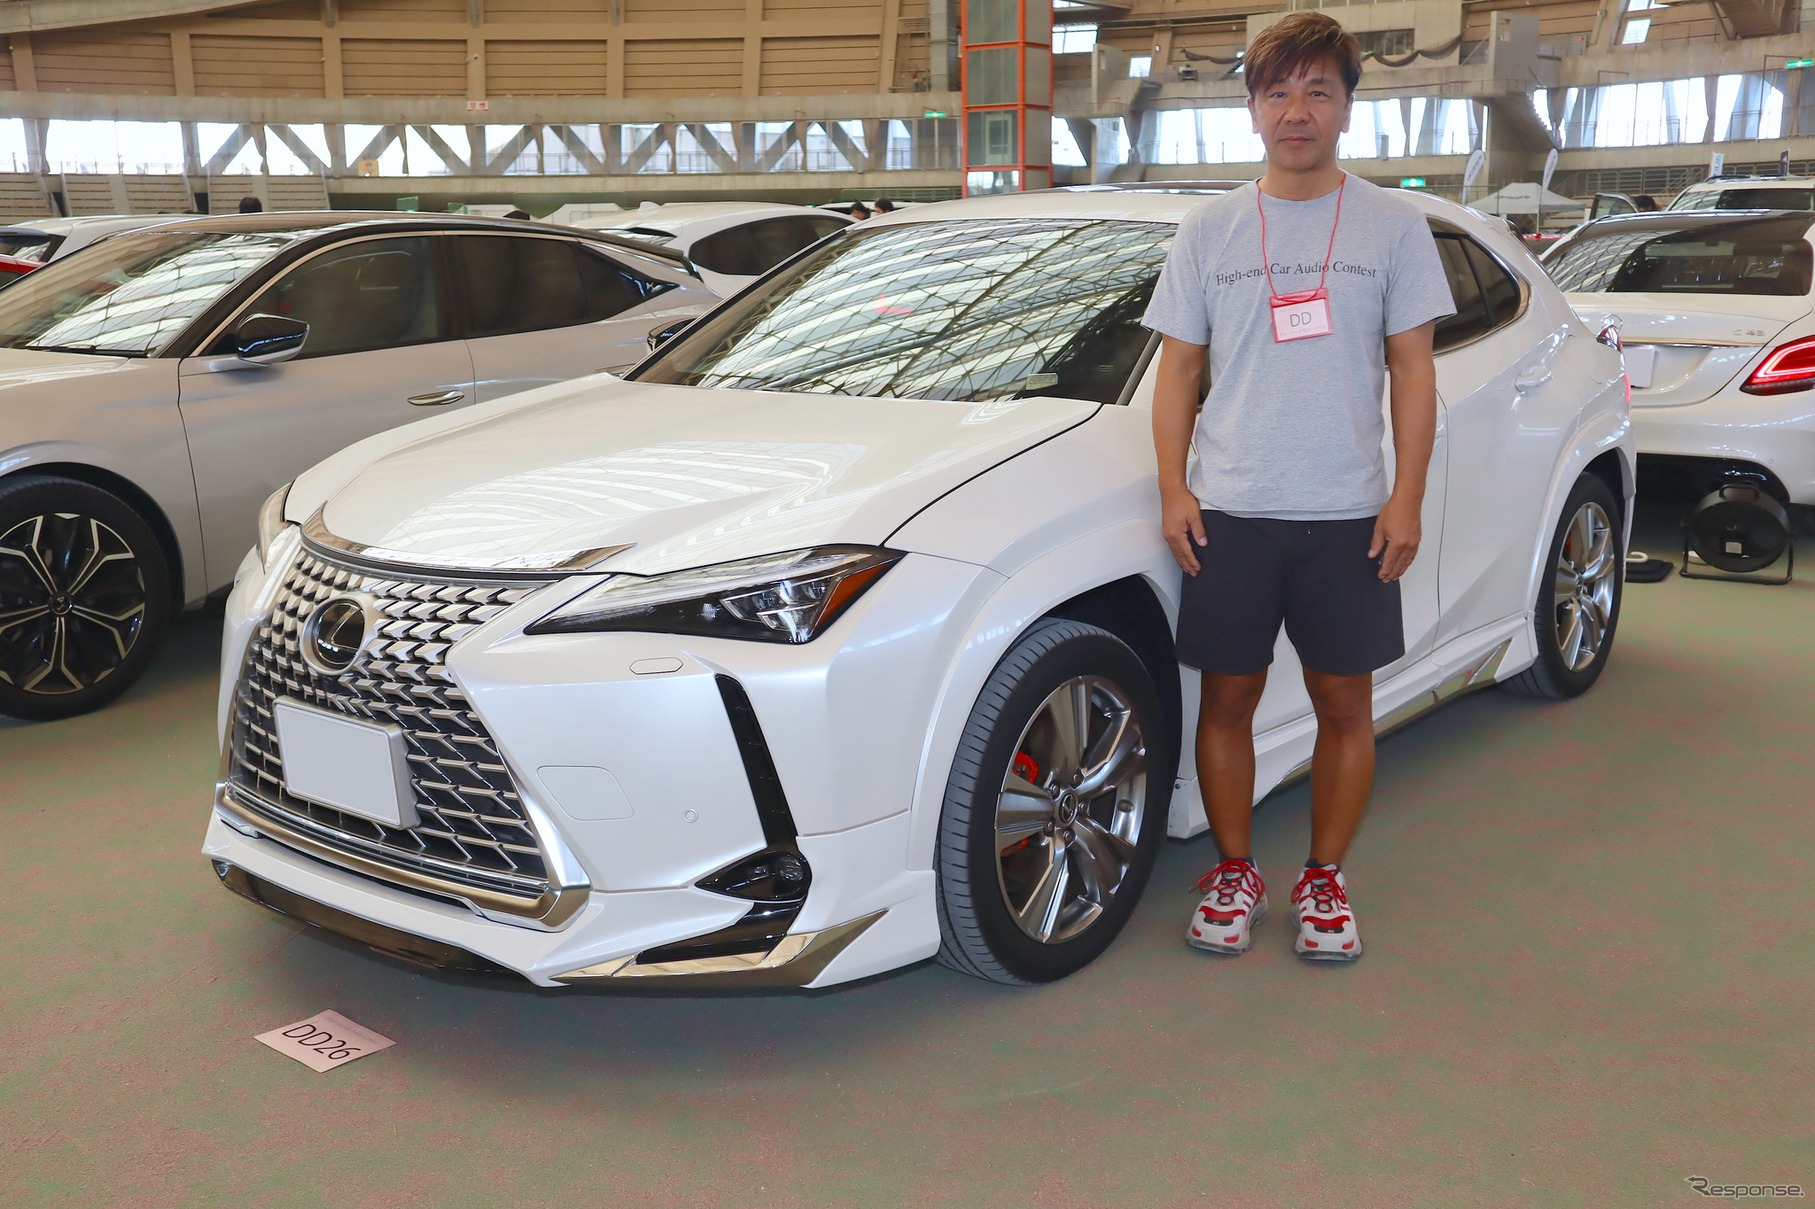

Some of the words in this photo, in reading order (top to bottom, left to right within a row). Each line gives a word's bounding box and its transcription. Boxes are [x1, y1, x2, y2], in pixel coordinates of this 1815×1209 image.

[1216, 264, 1267, 286] High-end
[1270, 262, 1292, 275] Car
[1294, 261, 1330, 275] Audio
[1333, 260, 1377, 279] Contest
[1289, 311, 1312, 328] DD
[281, 1023, 362, 1060] DD26
